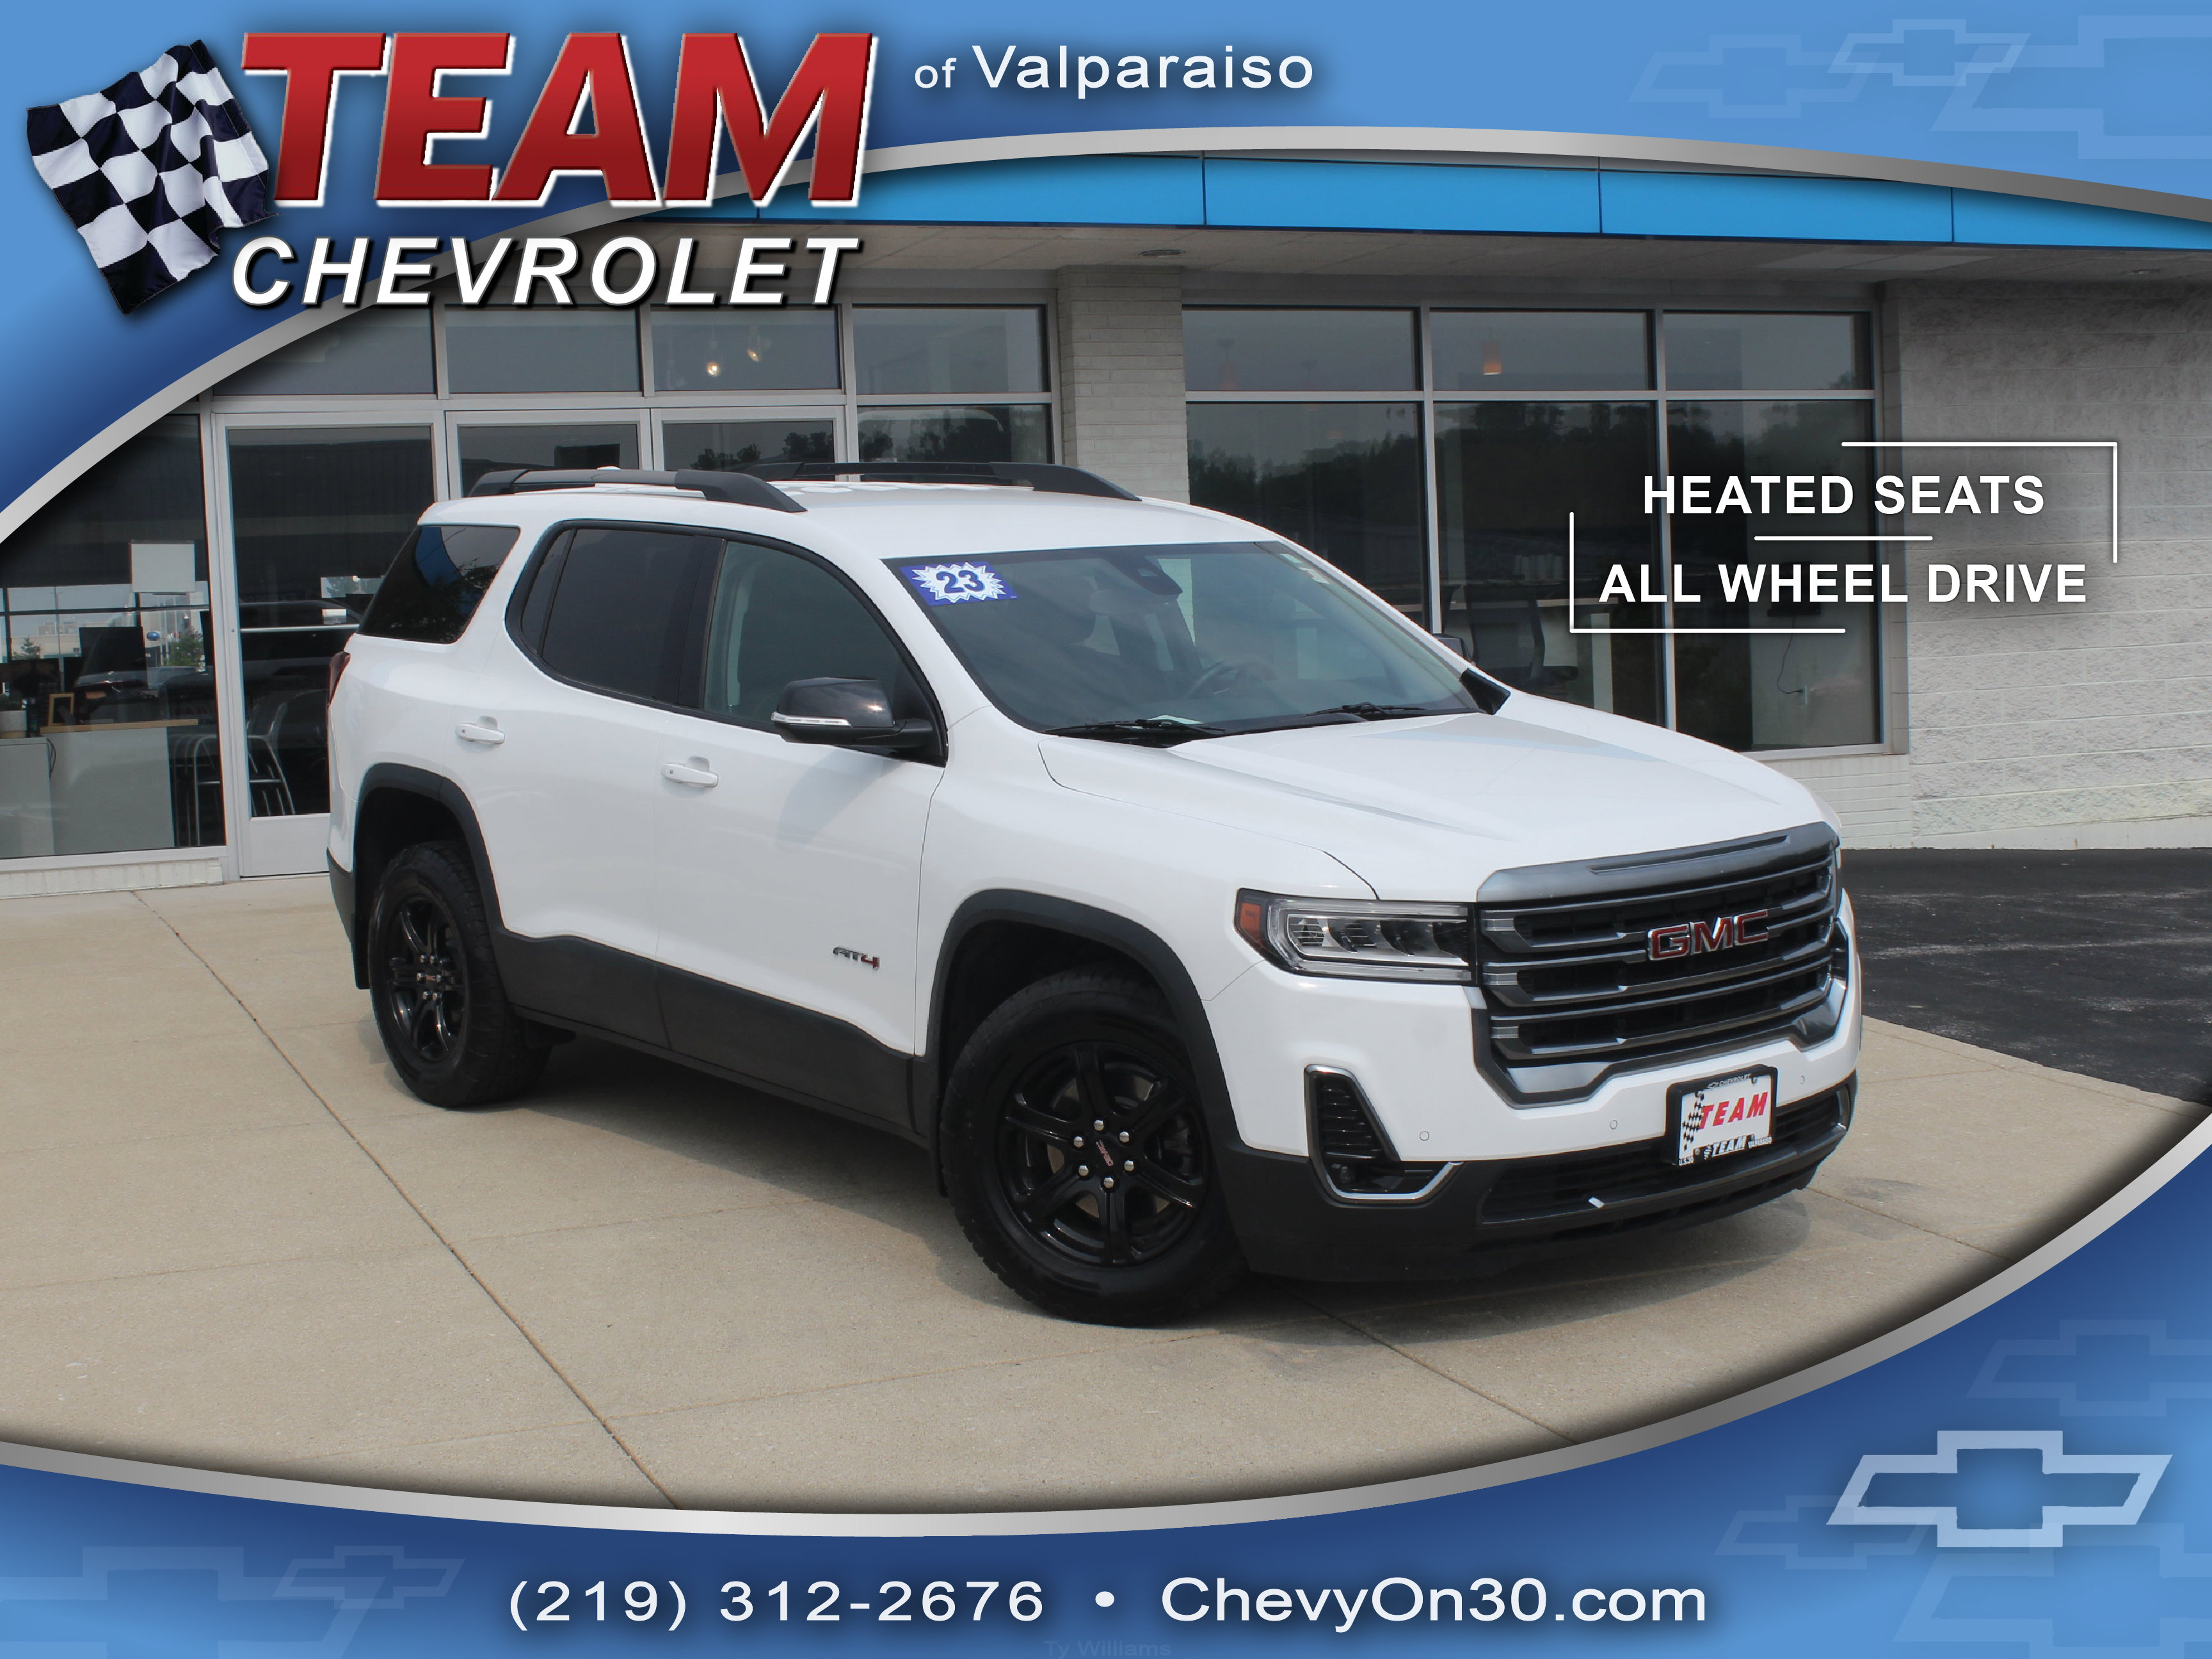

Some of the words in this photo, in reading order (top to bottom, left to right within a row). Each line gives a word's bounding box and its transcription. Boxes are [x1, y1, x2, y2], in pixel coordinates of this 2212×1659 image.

[936, 570, 984, 593] 23
[1647, 909, 1768, 960] GMC
[1699, 1091, 1768, 1130] TEAM
[1711, 1135, 1747, 1157] TEAM
